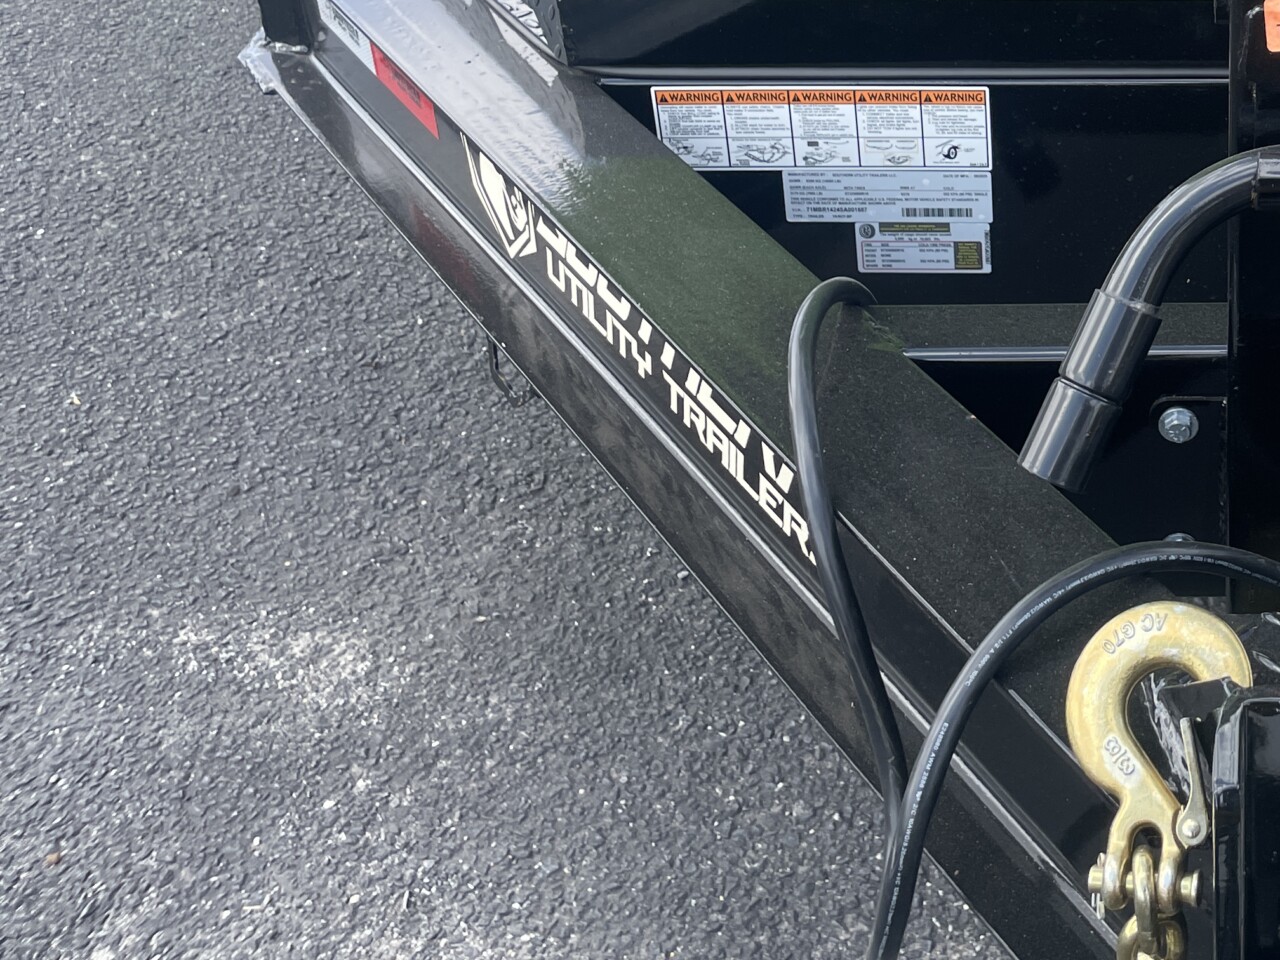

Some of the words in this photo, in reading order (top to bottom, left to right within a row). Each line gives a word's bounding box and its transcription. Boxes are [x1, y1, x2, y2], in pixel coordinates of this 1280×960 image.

[669, 93, 720, 102] WARNING
[735, 93, 786, 102] WARNING
[802, 93, 852, 102] WARNING
[867, 93, 918, 102] WARNING
[933, 93, 983, 103] WARNING
[545, 246, 652, 379] UTILITY
[662, 369, 817, 566] TRAILER
[1141, 613, 1168, 632] AC
[1102, 620, 1136, 655] G70
